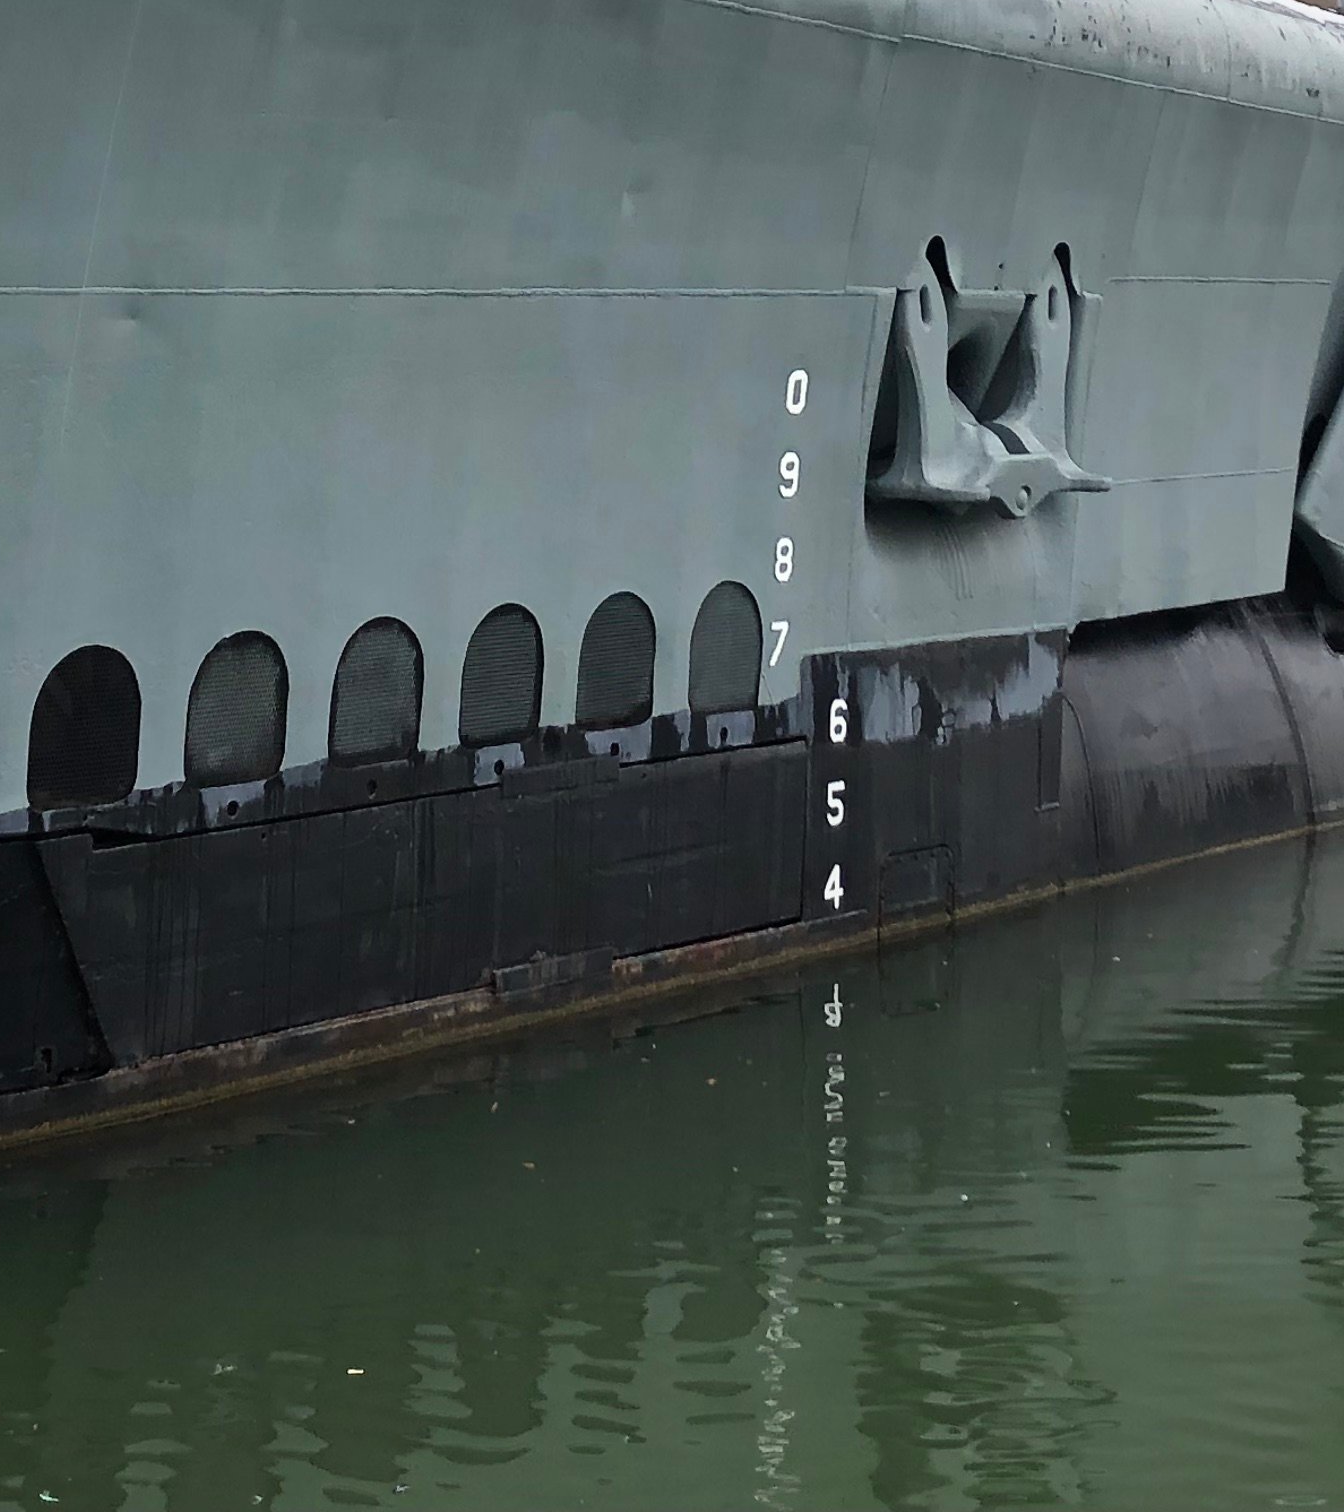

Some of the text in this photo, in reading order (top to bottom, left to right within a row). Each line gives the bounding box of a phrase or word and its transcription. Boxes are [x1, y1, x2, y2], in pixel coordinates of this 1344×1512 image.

[786, 369, 809, 415] 0
[779, 451, 800, 498] 9
[774, 537, 794, 583] 8
[769, 620, 789, 667] 7
[829, 698, 848, 744] 6
[826, 780, 846, 827] 5
[824, 863, 844, 910] 4
